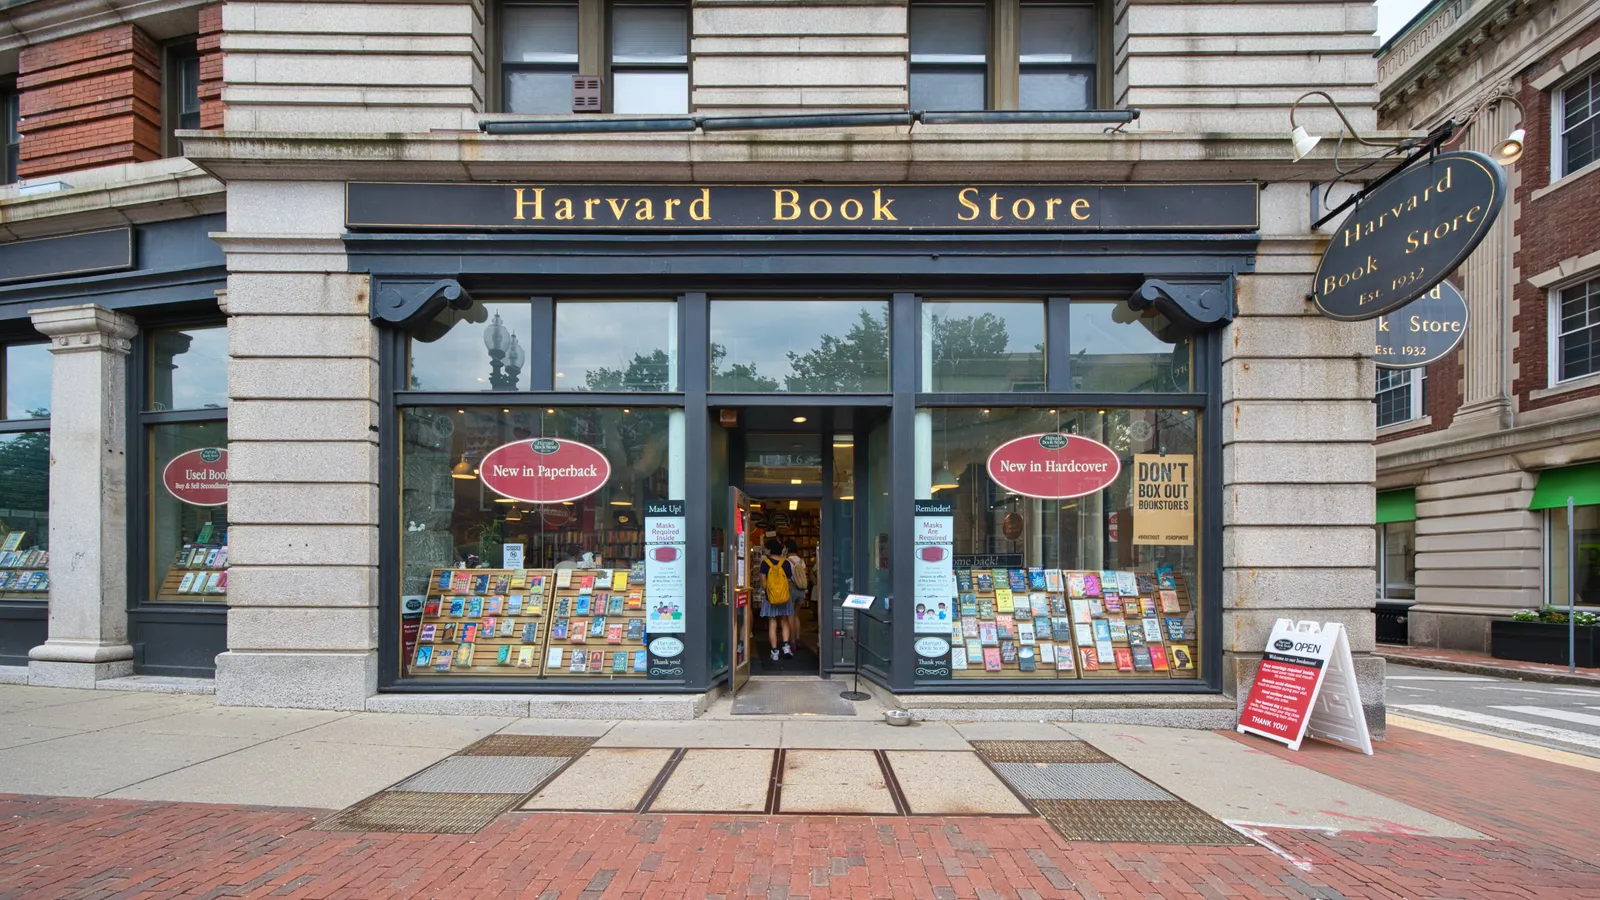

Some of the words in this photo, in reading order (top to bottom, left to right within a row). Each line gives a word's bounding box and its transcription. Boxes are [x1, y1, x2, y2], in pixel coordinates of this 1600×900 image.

[514, 187, 711, 221] Harvard
[773, 188, 896, 221] Book
[957, 187, 1090, 221] Store
[1345, 166, 1451, 247] Harvard
[1323, 255, 1378, 296] Book
[1405, 205, 1480, 254] Store
[1359, 288, 1384, 306] Est.
[1391, 267, 1425, 290] 1932
[1410, 315, 1460, 332] Store
[1375, 345, 1396, 355] Est.
[1402, 346, 1427, 356] 1932
[493, 464, 519, 477] New
[522, 466, 534, 477] in
[538, 464, 598, 480] Paperback
[1000, 460, 1026, 472] New
[1030, 460, 1042, 472] in
[1045, 460, 1108, 472] Hardcover
[186, 468, 206, 480] Used
[175, 482, 184, 490] Buy
[1138, 484, 1161, 498] BOX
[1164, 484, 1188, 498] OUT
[669, 505, 682, 514] Up!
[915, 504, 950, 512] Reminder!
[1138, 500, 1189, 510] BOOKSTORES
[973, 556, 999, 566] back!
[1294, 642, 1322, 654] OPEN
[1252, 716, 1272, 727] THANK
[1273, 722, 1288, 732] YOU!
